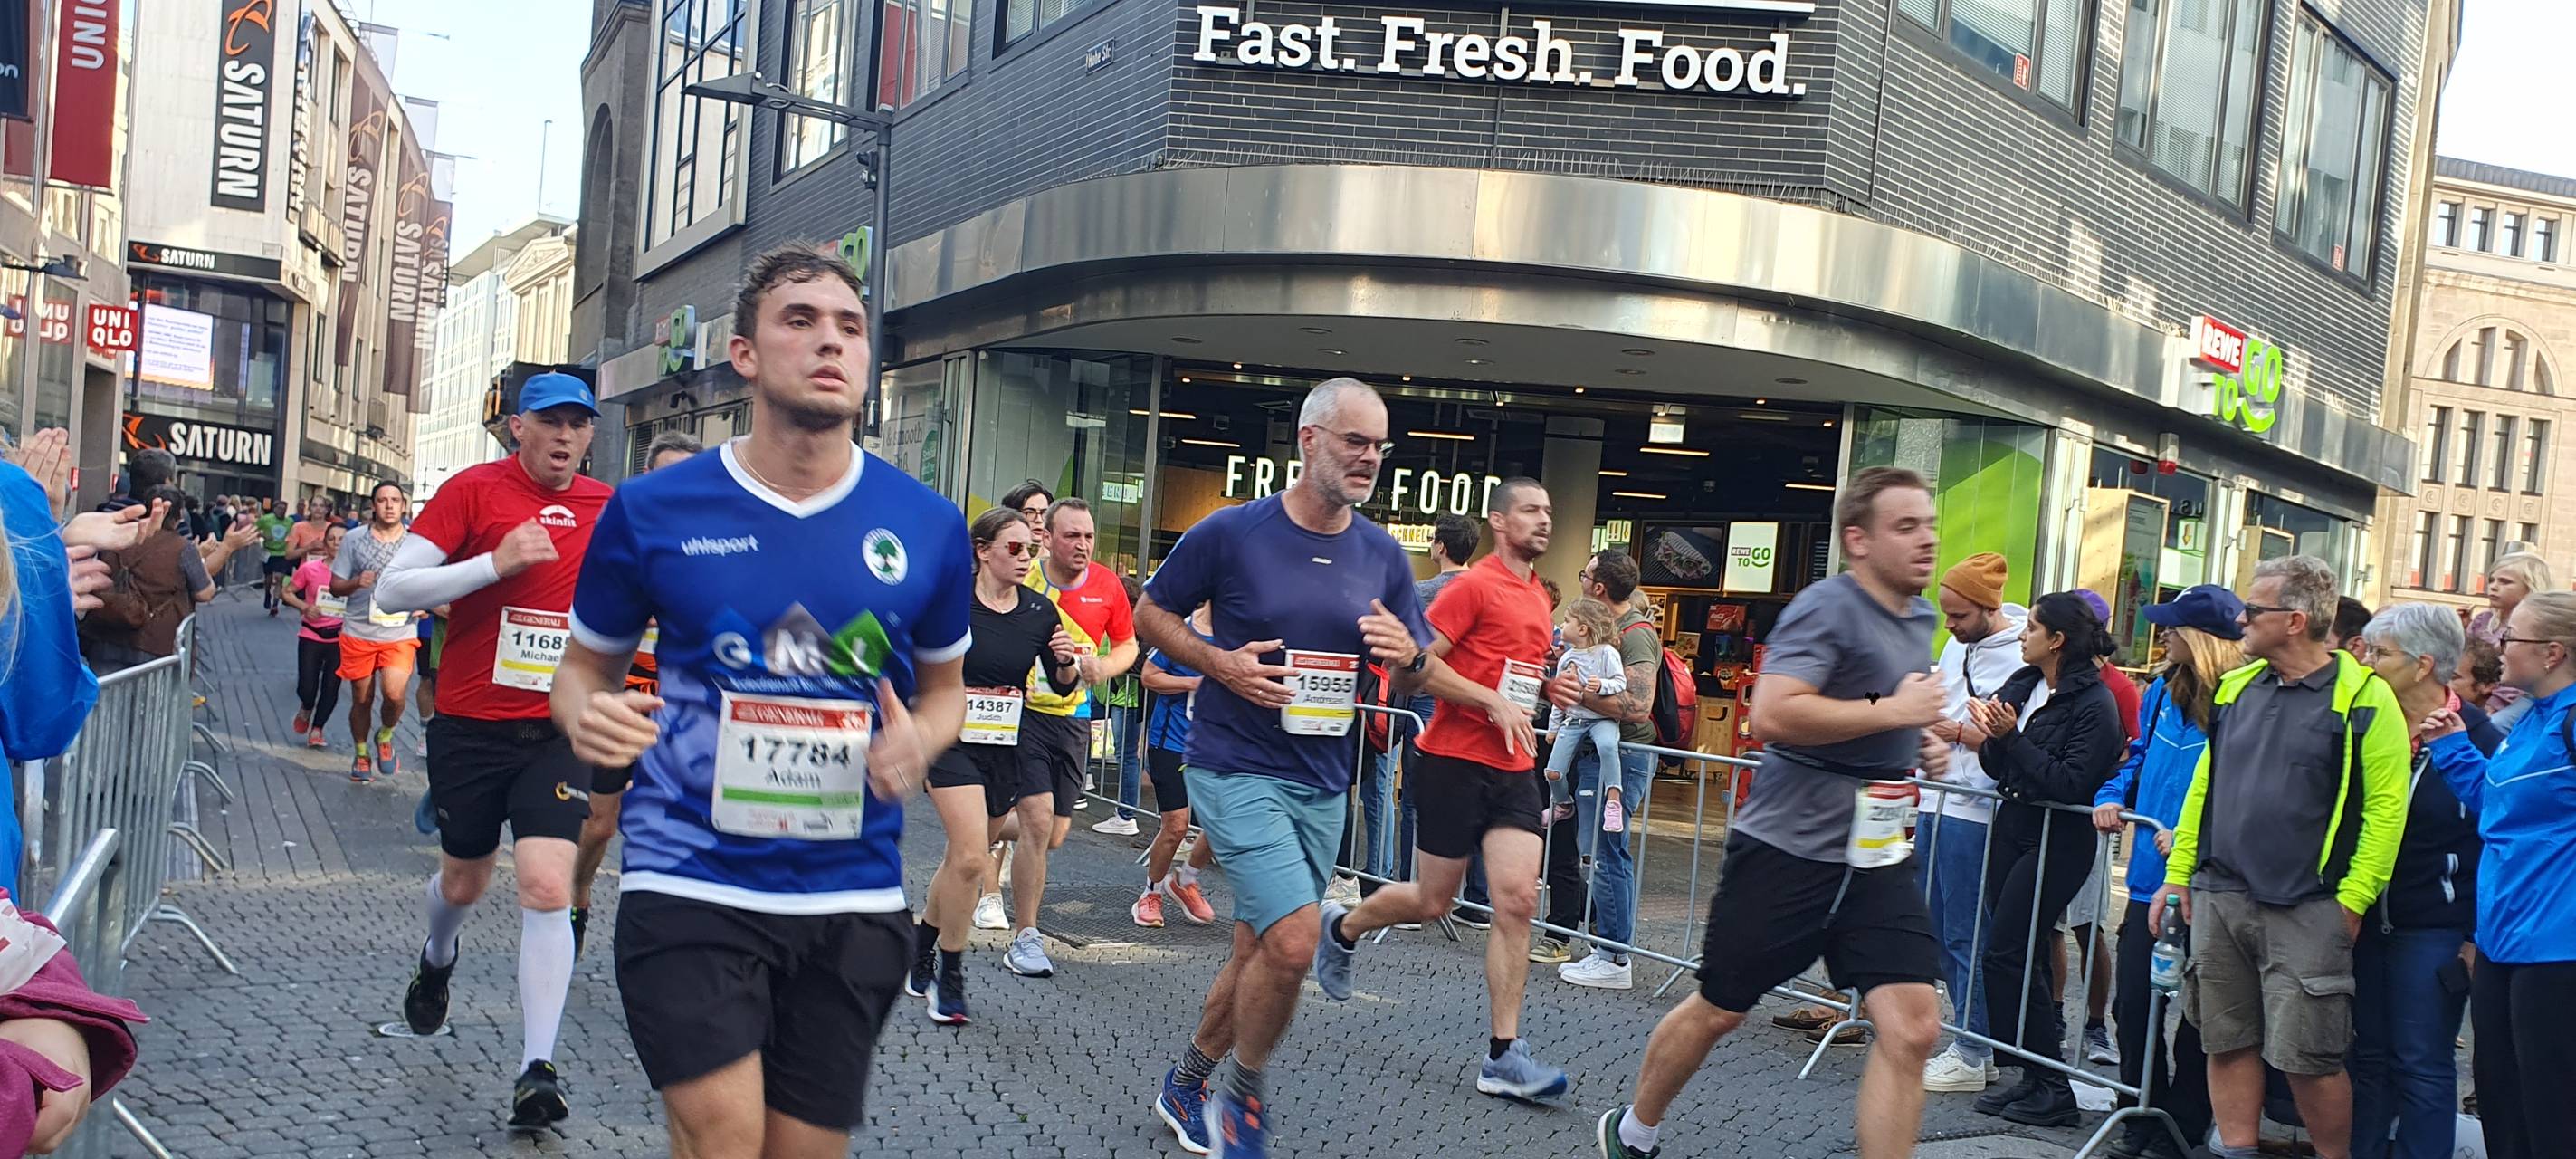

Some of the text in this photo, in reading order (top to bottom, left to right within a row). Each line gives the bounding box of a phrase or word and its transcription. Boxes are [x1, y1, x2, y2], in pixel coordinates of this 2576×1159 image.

[72, 0, 107, 69] UNI
[1193, 5, 1807, 96] Fast. Fresh. Food.
[217, 60, 265, 198] SATURN
[341, 166, 372, 283] SATURN
[160, 248, 215, 269] SATURN
[390, 220, 423, 322] SATURN
[93, 308, 130, 329] UNI
[92, 327, 133, 347] QLO
[2201, 322, 2242, 367] REWE
[2213, 339, 2282, 421] TO GO
[168, 421, 272, 466] SATURN
[540, 517, 577, 528] skinfit
[681, 533, 760, 557] uhlsport
[1731, 547, 1751, 556] REWE
[1737, 547, 1771, 568] TO GO
[1297, 675, 1353, 693] 15955
[967, 700, 1014, 713] 14387
[976, 713, 1002, 722] Judith
[739, 733, 852, 769] 17784
[765, 768, 821, 789] Adam
